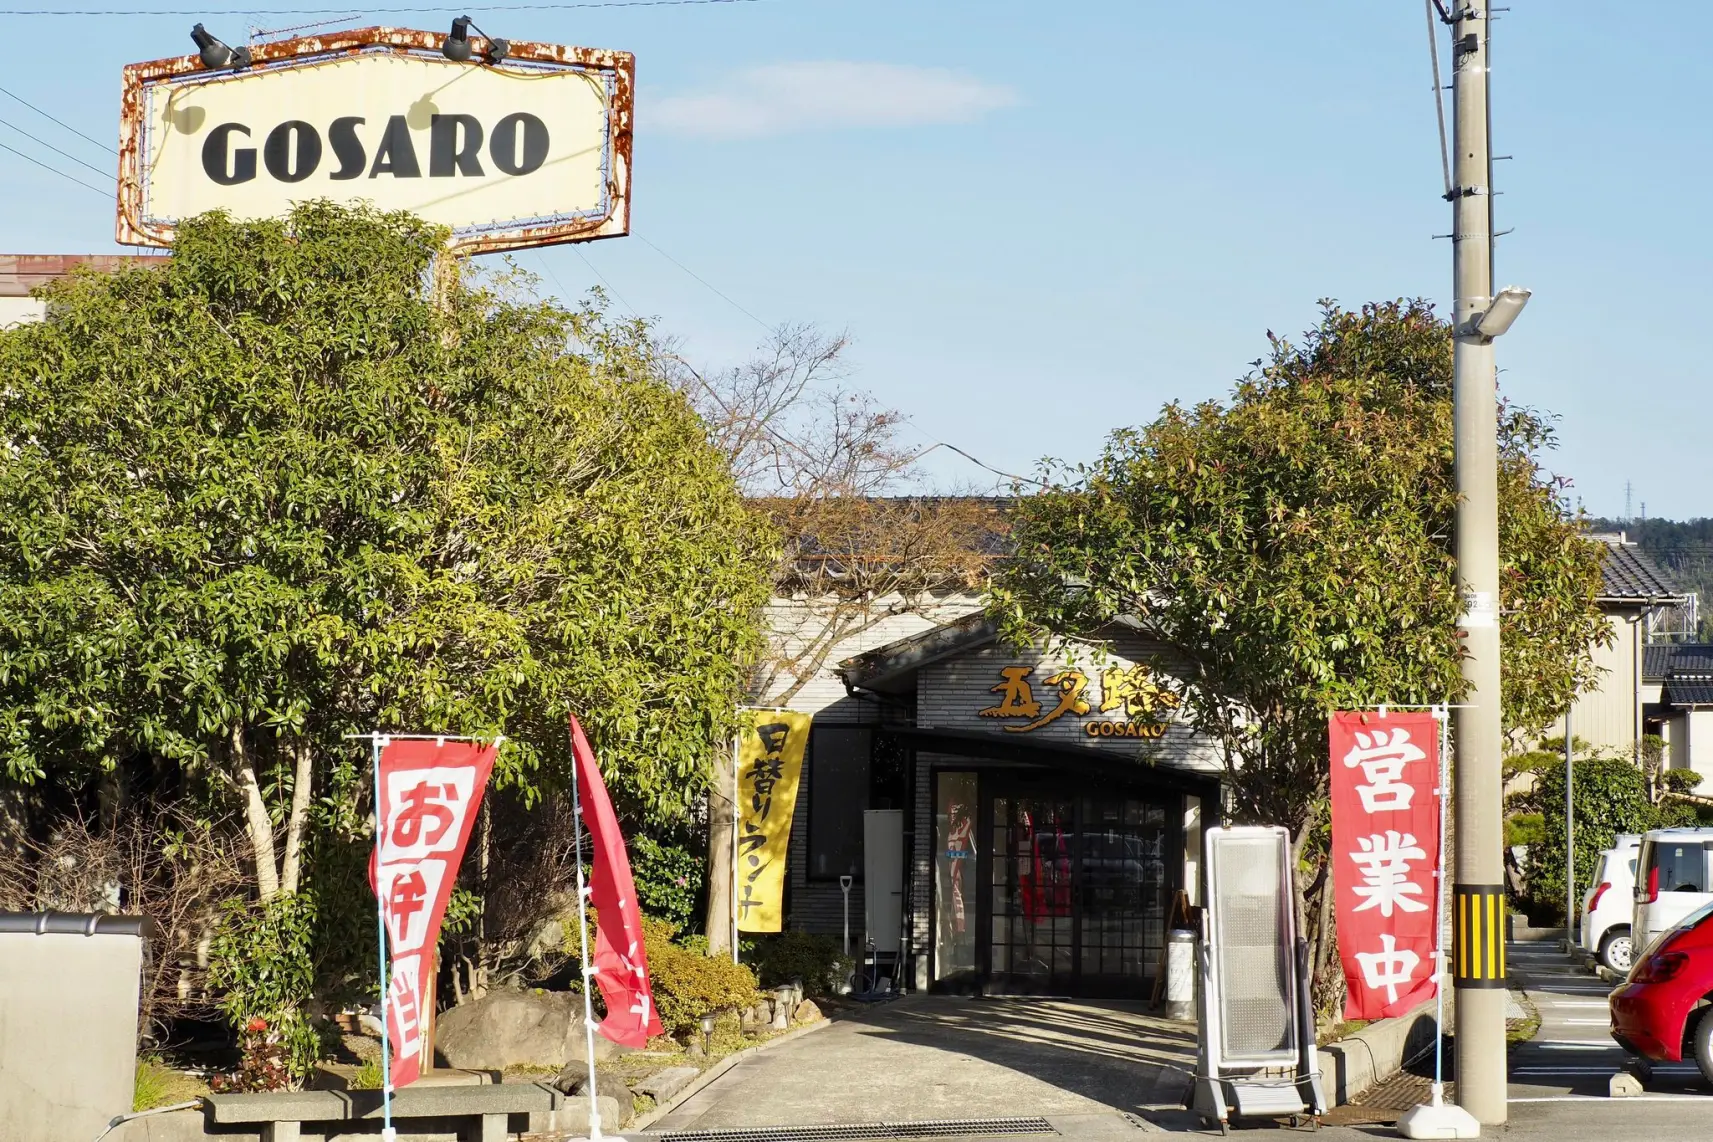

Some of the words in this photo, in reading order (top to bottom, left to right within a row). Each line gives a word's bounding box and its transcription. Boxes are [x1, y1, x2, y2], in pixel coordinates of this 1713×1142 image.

[201, 111, 550, 186] GOSARO
[1086, 720, 1168, 738] GOSARO
[739, 723, 790, 921] 日替りランチ
[1343, 727, 1428, 1005] 営業中
